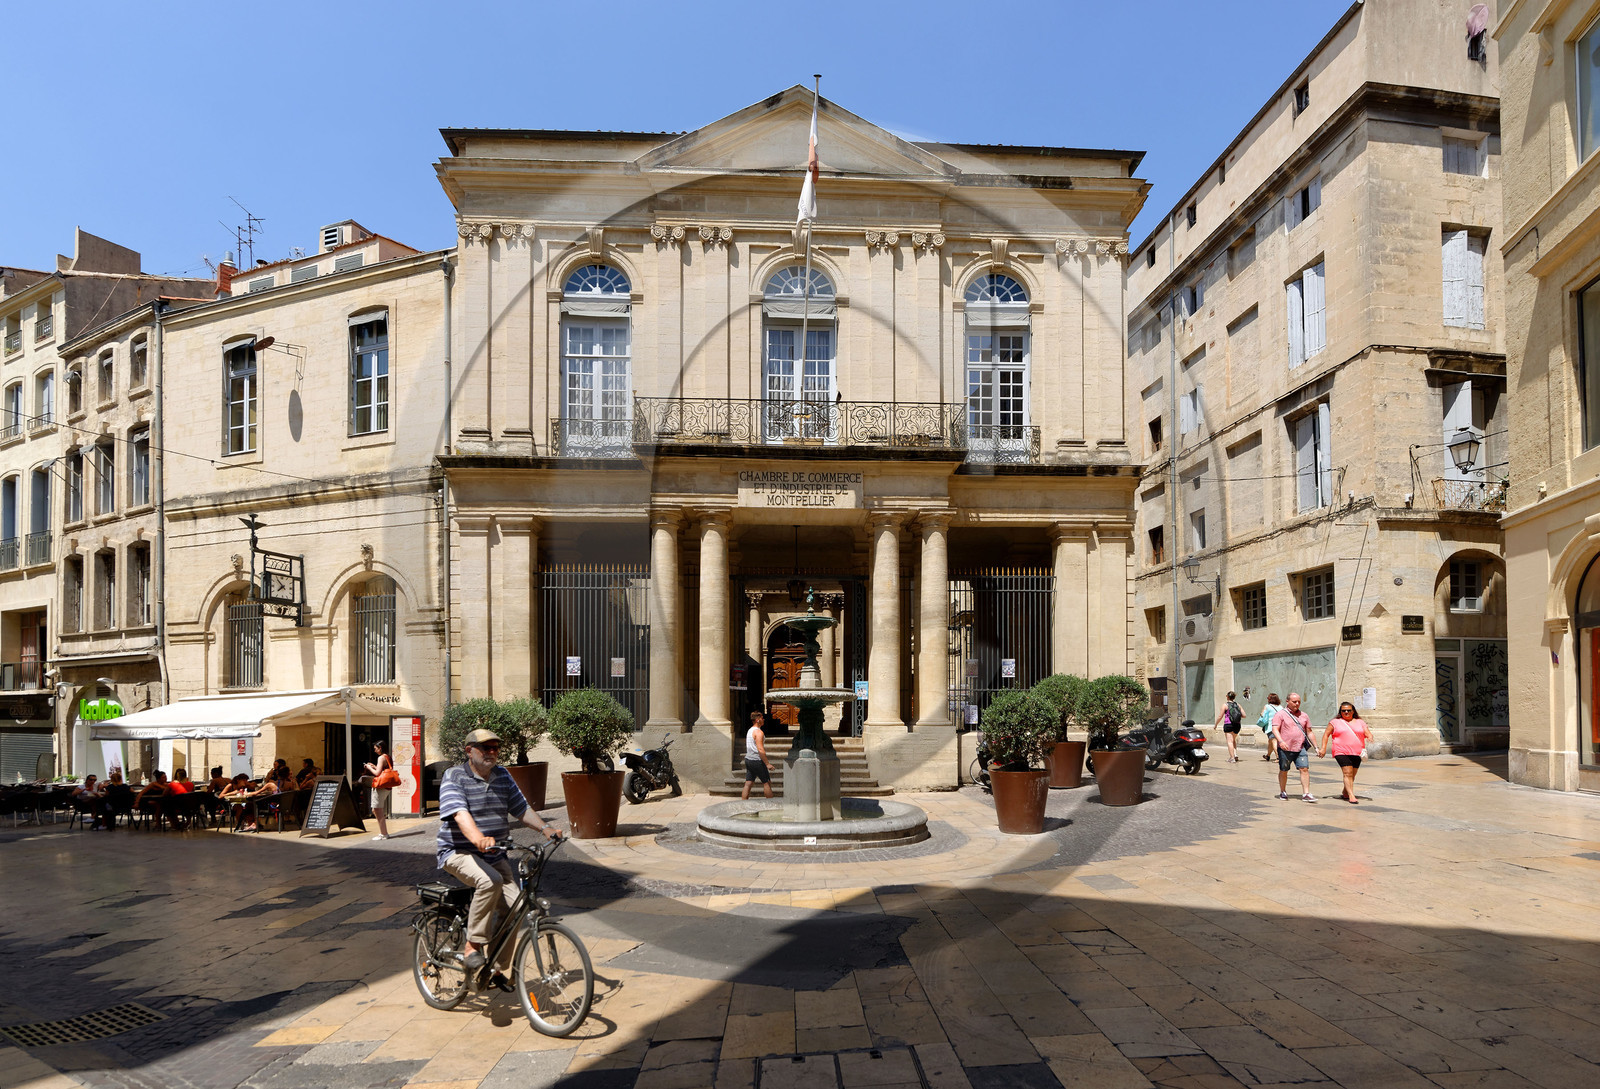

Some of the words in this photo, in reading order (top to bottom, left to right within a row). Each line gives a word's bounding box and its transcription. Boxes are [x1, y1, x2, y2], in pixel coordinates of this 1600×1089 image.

[740, 471, 789, 482] CHAMBRE
[792, 472, 806, 483] DE
[808, 472, 862, 484] COMMERCE
[754, 483, 766, 494] ET
[770, 483, 832, 495] D'INDUSTRIE
[835, 484, 848, 495] DE
[767, 495, 836, 506] MONTPELLIER
